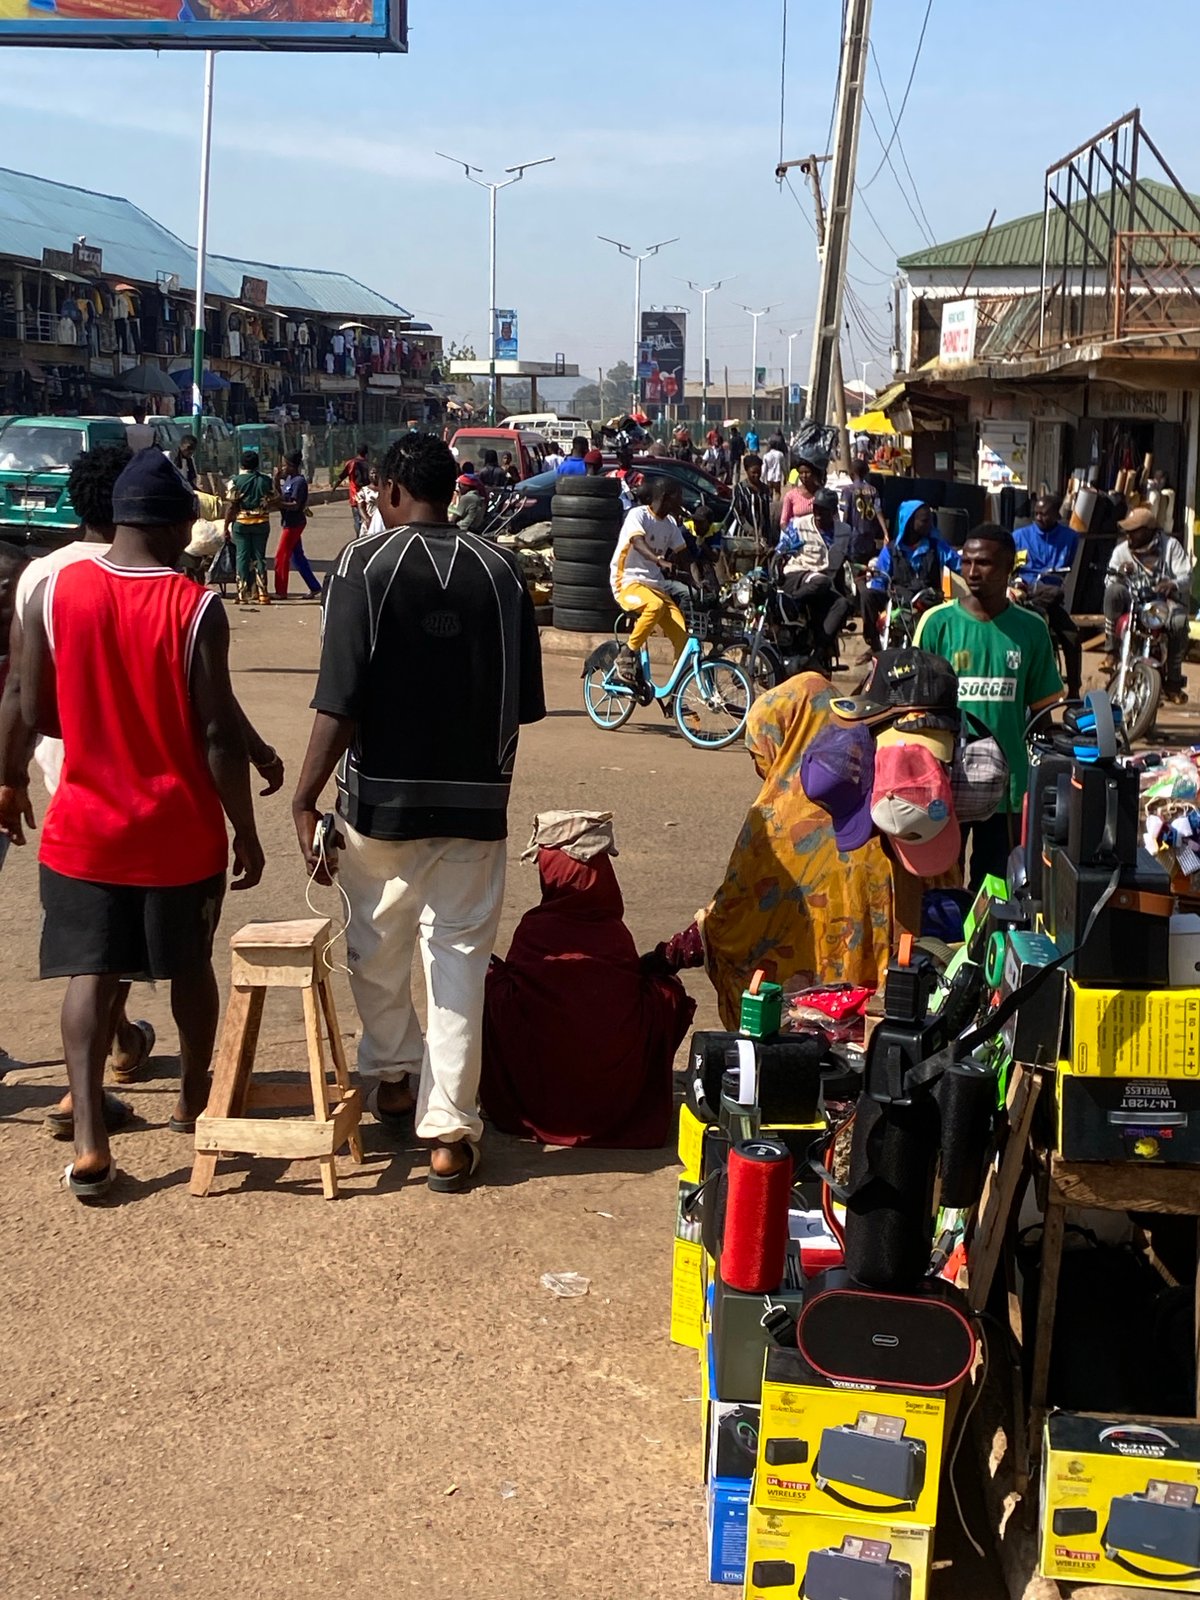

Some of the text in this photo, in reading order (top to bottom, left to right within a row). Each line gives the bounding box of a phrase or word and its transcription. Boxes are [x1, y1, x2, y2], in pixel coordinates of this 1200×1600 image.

[959, 681, 1014, 697] SOCCER
[1125, 1086, 1170, 1095] WIRELESS
[1120, 1099, 1177, 1109] LN-712BT
[830, 1380, 877, 1390] WIRELESS
[1119, 1448, 1166, 1457] WIRELESS
[767, 1490, 807, 1500] WIRELESS
[1055, 1560, 1096, 1569] WIRELESS
